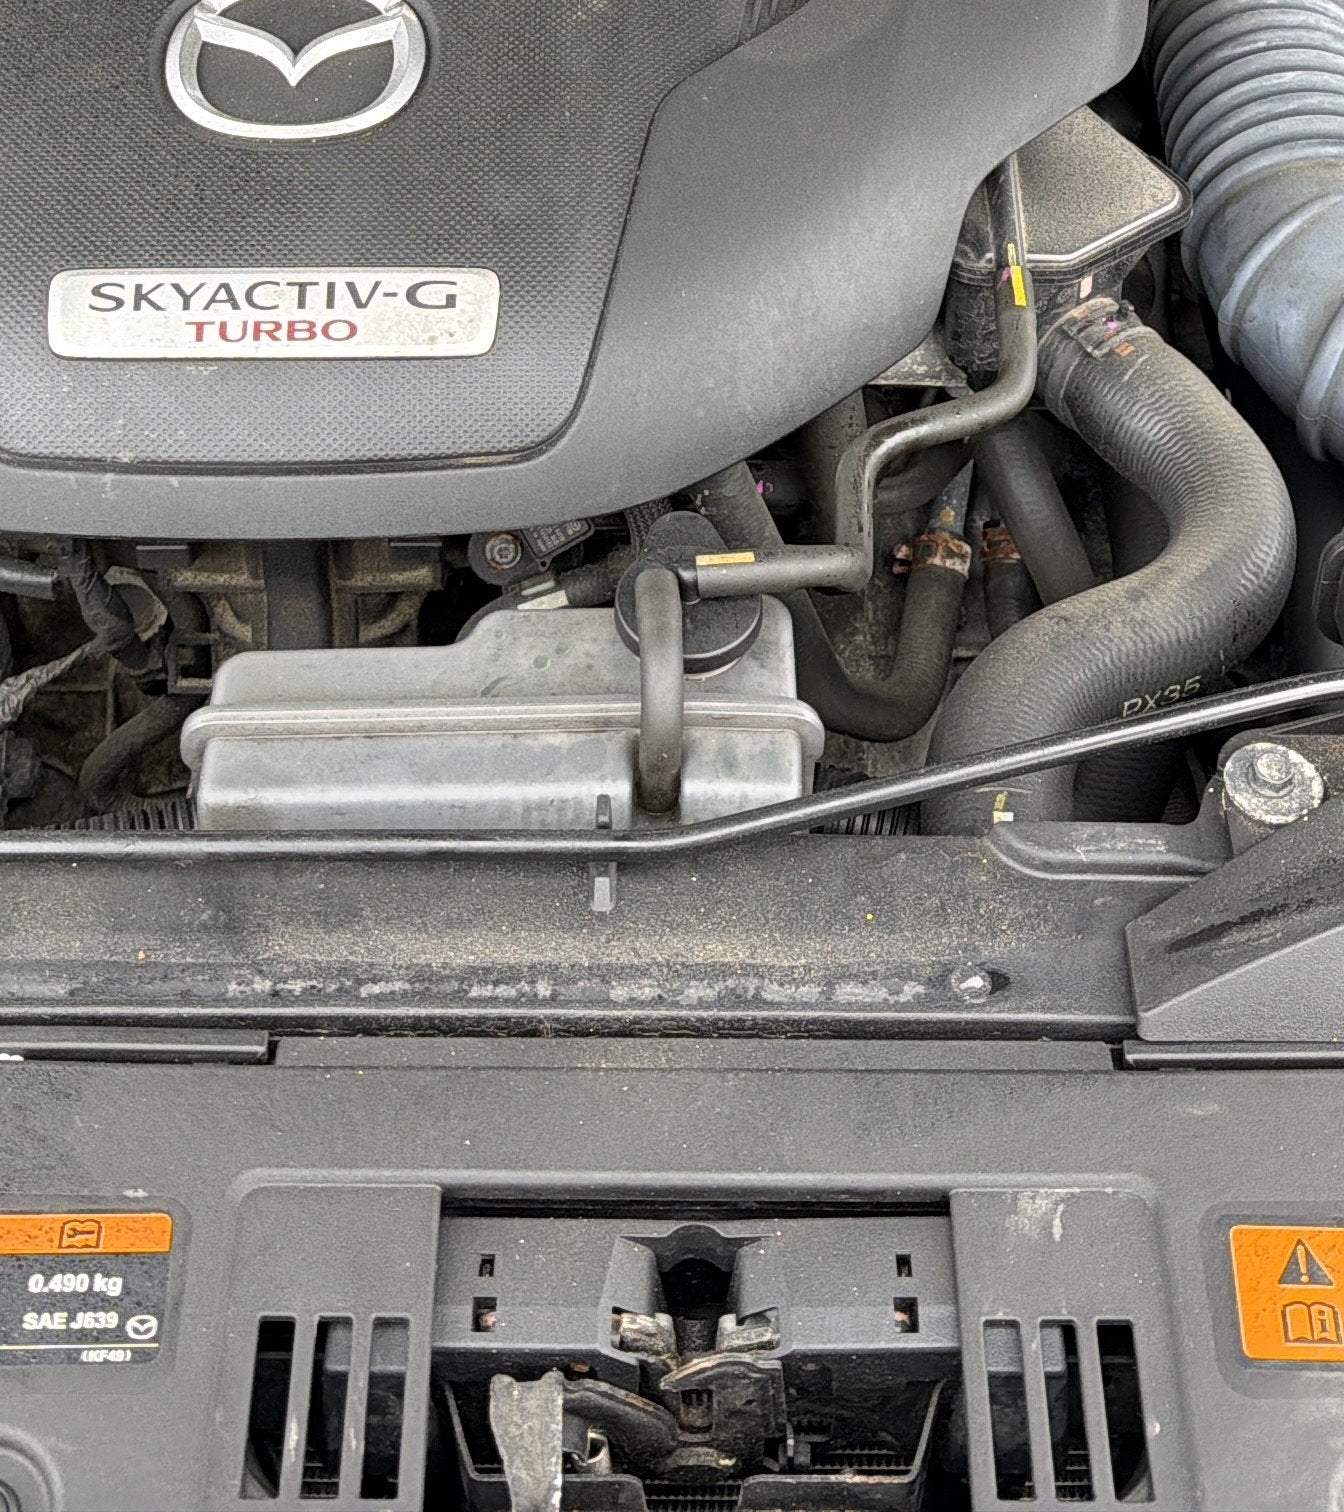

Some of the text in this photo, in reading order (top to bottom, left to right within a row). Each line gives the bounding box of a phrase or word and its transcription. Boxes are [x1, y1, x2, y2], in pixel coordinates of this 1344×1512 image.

[88, 279, 458, 313] SKYACTIV-G
[185, 319, 359, 343] TURBO
[27, 1273, 90, 1294] 0.490
[93, 1272, 123, 1297] kg
[22, 1312, 68, 1331] SAE
[69, 1311, 119, 1330] J639
